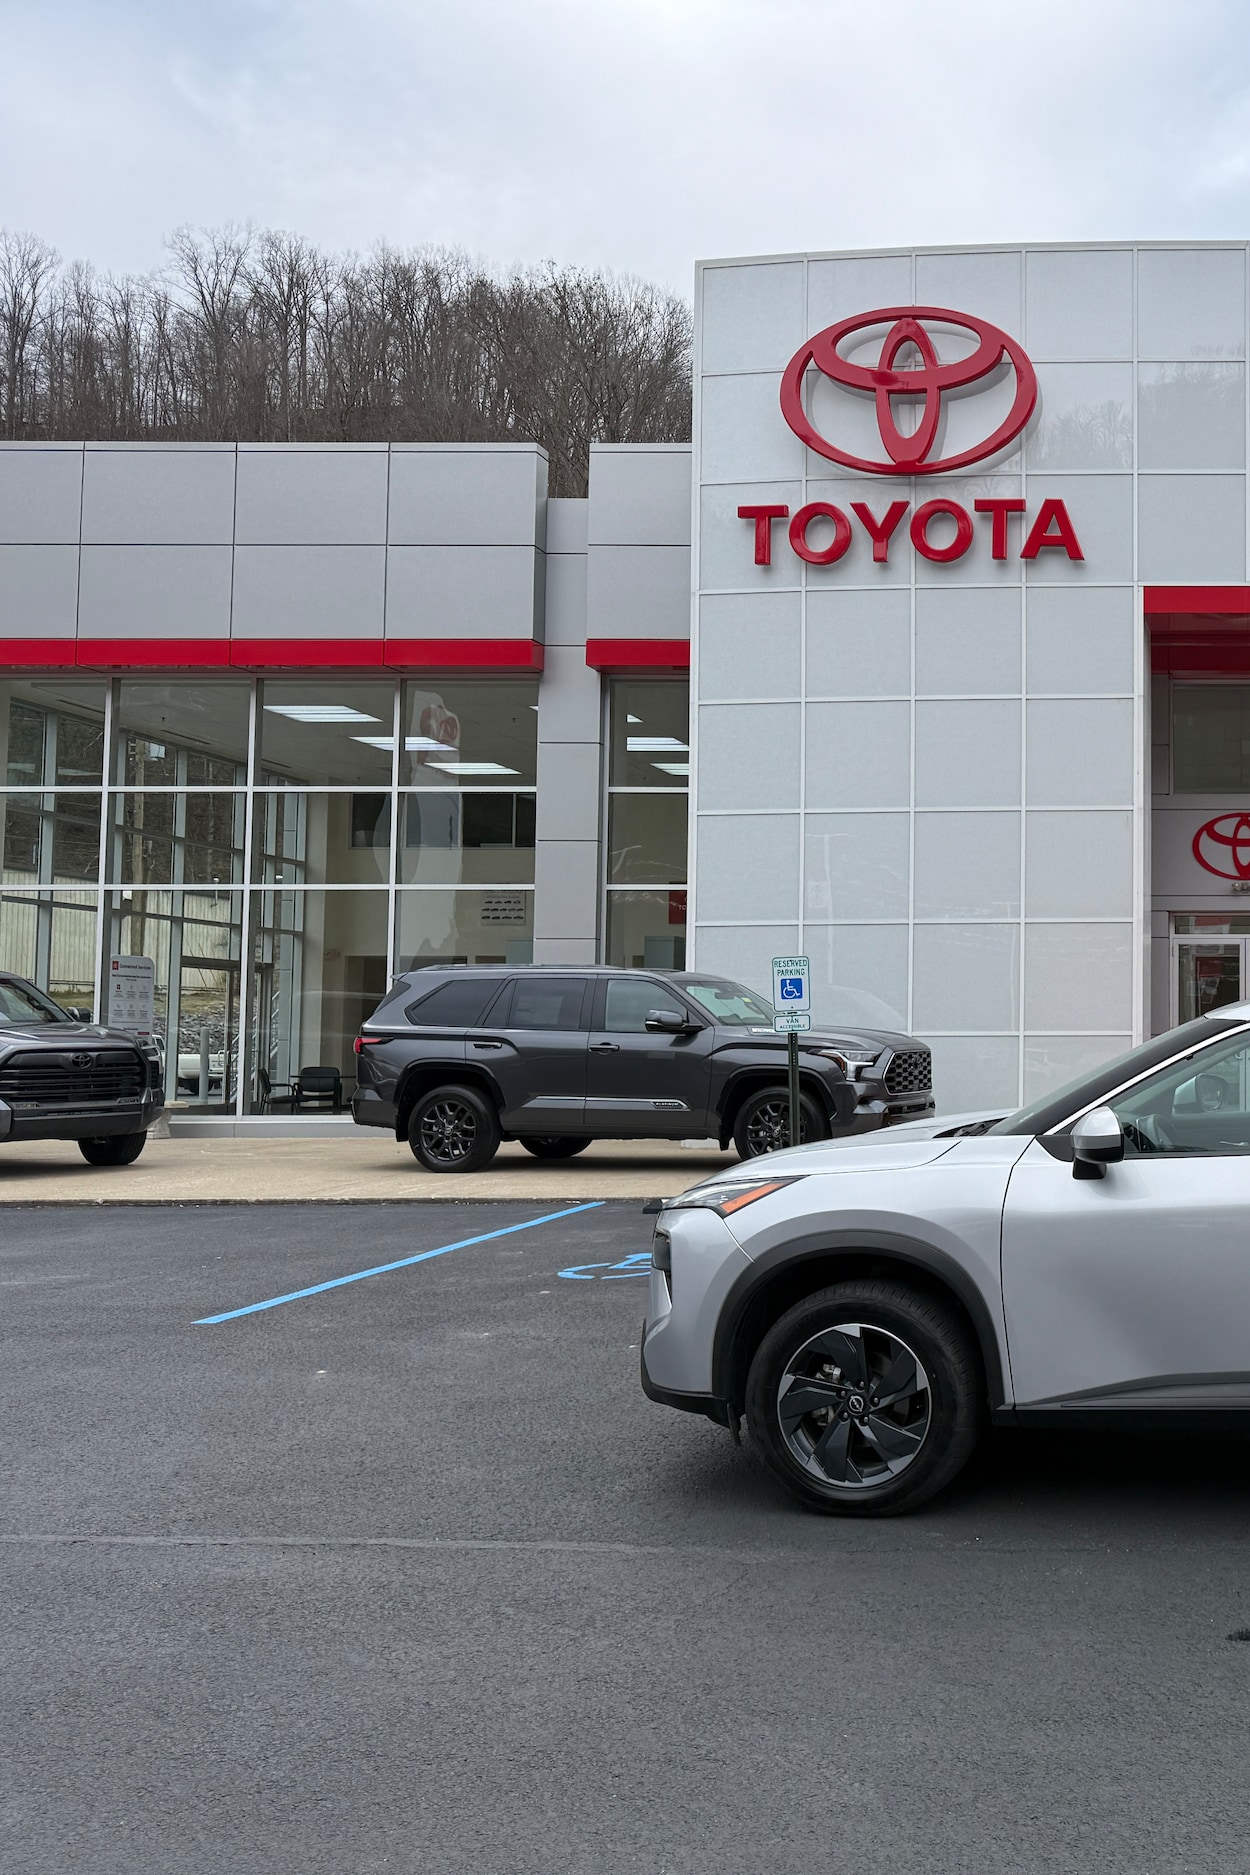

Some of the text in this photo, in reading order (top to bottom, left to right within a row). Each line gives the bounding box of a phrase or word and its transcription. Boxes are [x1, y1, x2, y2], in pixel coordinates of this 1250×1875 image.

[737, 498, 1085, 566] TOYOTA
[774, 959, 807, 968] RESERVED
[777, 968, 805, 977] PARKING
